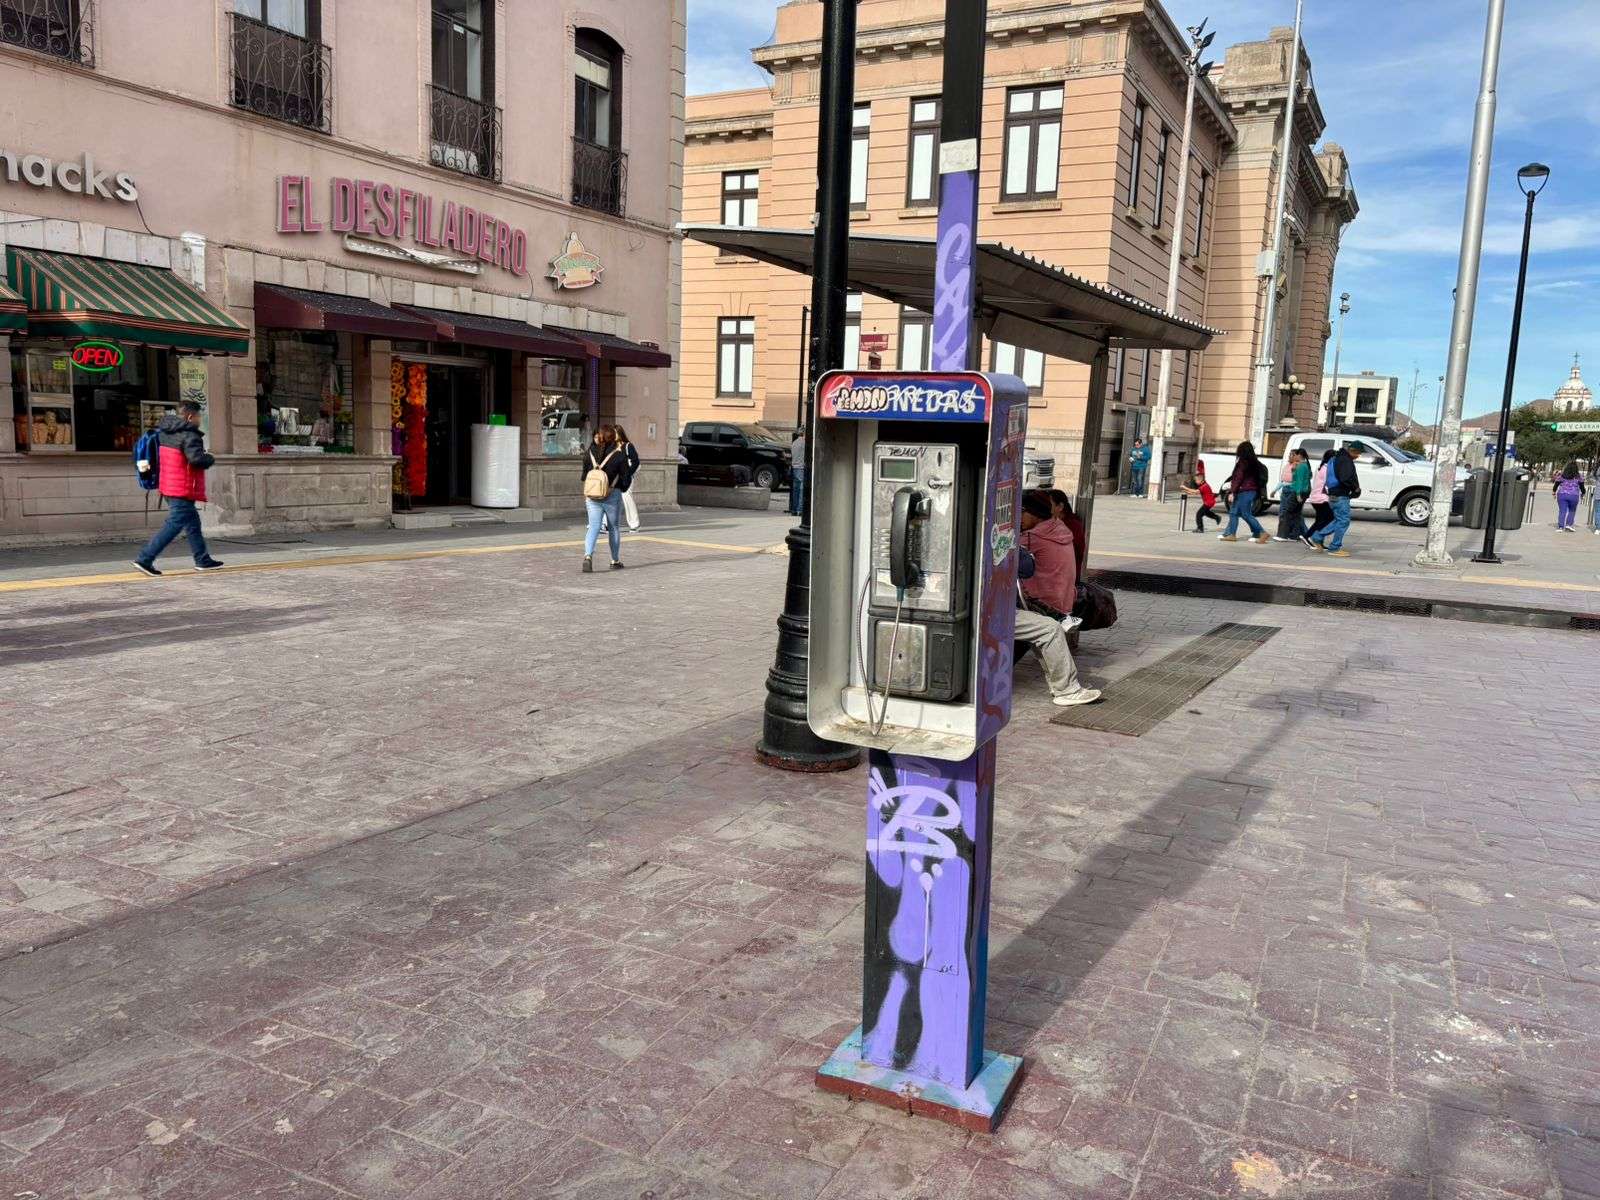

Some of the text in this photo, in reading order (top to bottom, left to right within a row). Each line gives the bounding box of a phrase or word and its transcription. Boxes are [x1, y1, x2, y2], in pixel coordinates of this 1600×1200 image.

[276, 175, 528, 277] EL DESFILADERO
[72, 347, 119, 367] OPEN
